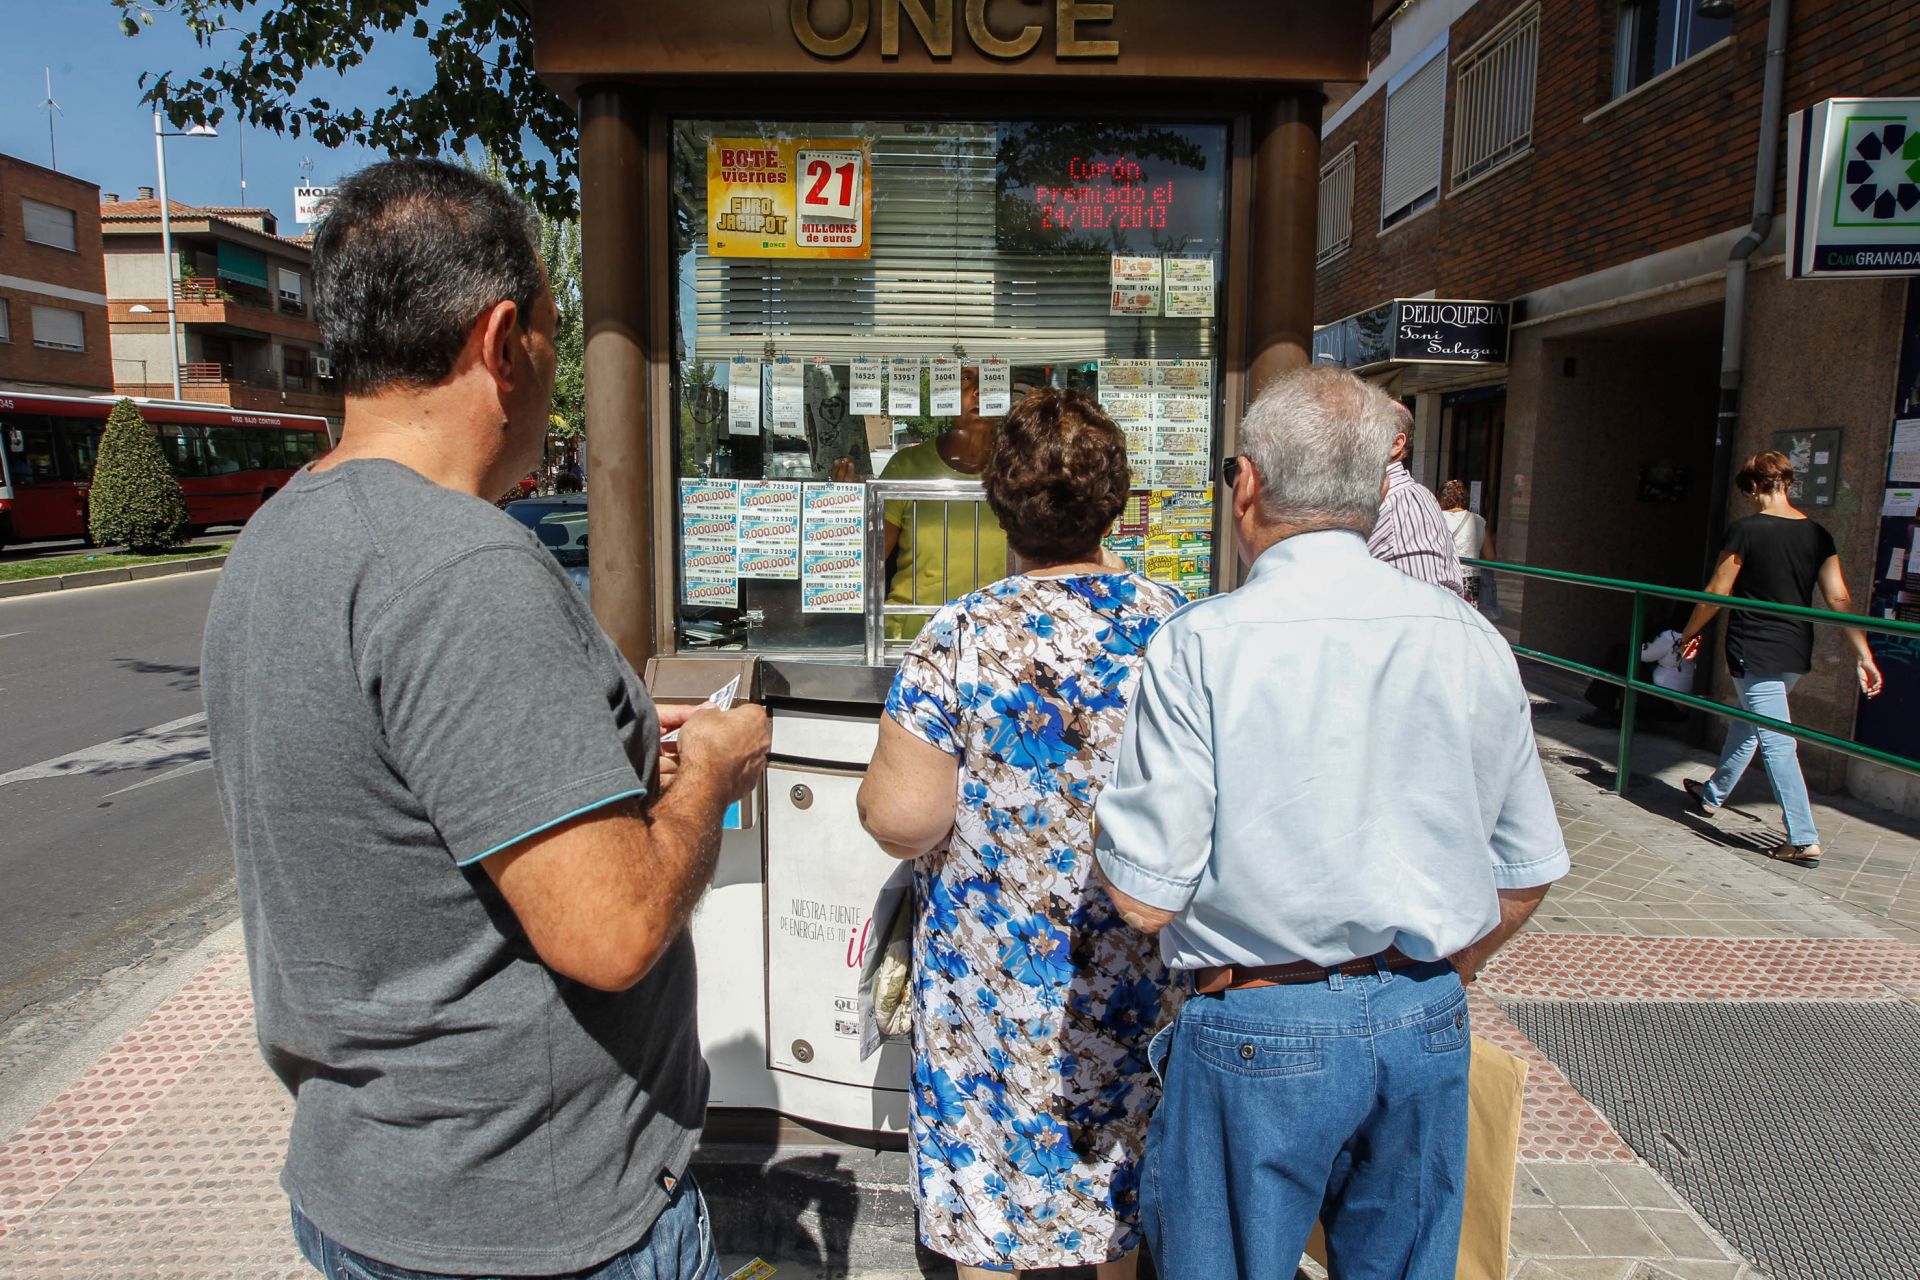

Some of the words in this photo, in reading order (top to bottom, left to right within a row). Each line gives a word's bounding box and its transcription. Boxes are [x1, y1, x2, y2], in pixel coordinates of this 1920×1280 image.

[790, 0, 1119, 56] ONCE
[721, 150, 778, 168] BOTE
[721, 168, 787, 183] viernes
[805, 160, 855, 206] 21
[1152, 180, 1173, 204] el
[730, 197, 774, 215] EURO
[1042, 205, 1168, 228] 24/09/2013
[717, 213, 787, 235] JACKPOT
[801, 224, 857, 233] MILLONES
[806, 233, 819, 242] de
[1402, 304, 1504, 328] PELUQUERIA
[1400, 325, 1443, 341] Toni
[791, 898, 827, 921] NUESTRA
[830, 904, 861, 926] FUENTE
[780, 916, 789, 931] DE
[827, 926, 835, 941] ES
[838, 928, 846, 943] TU
